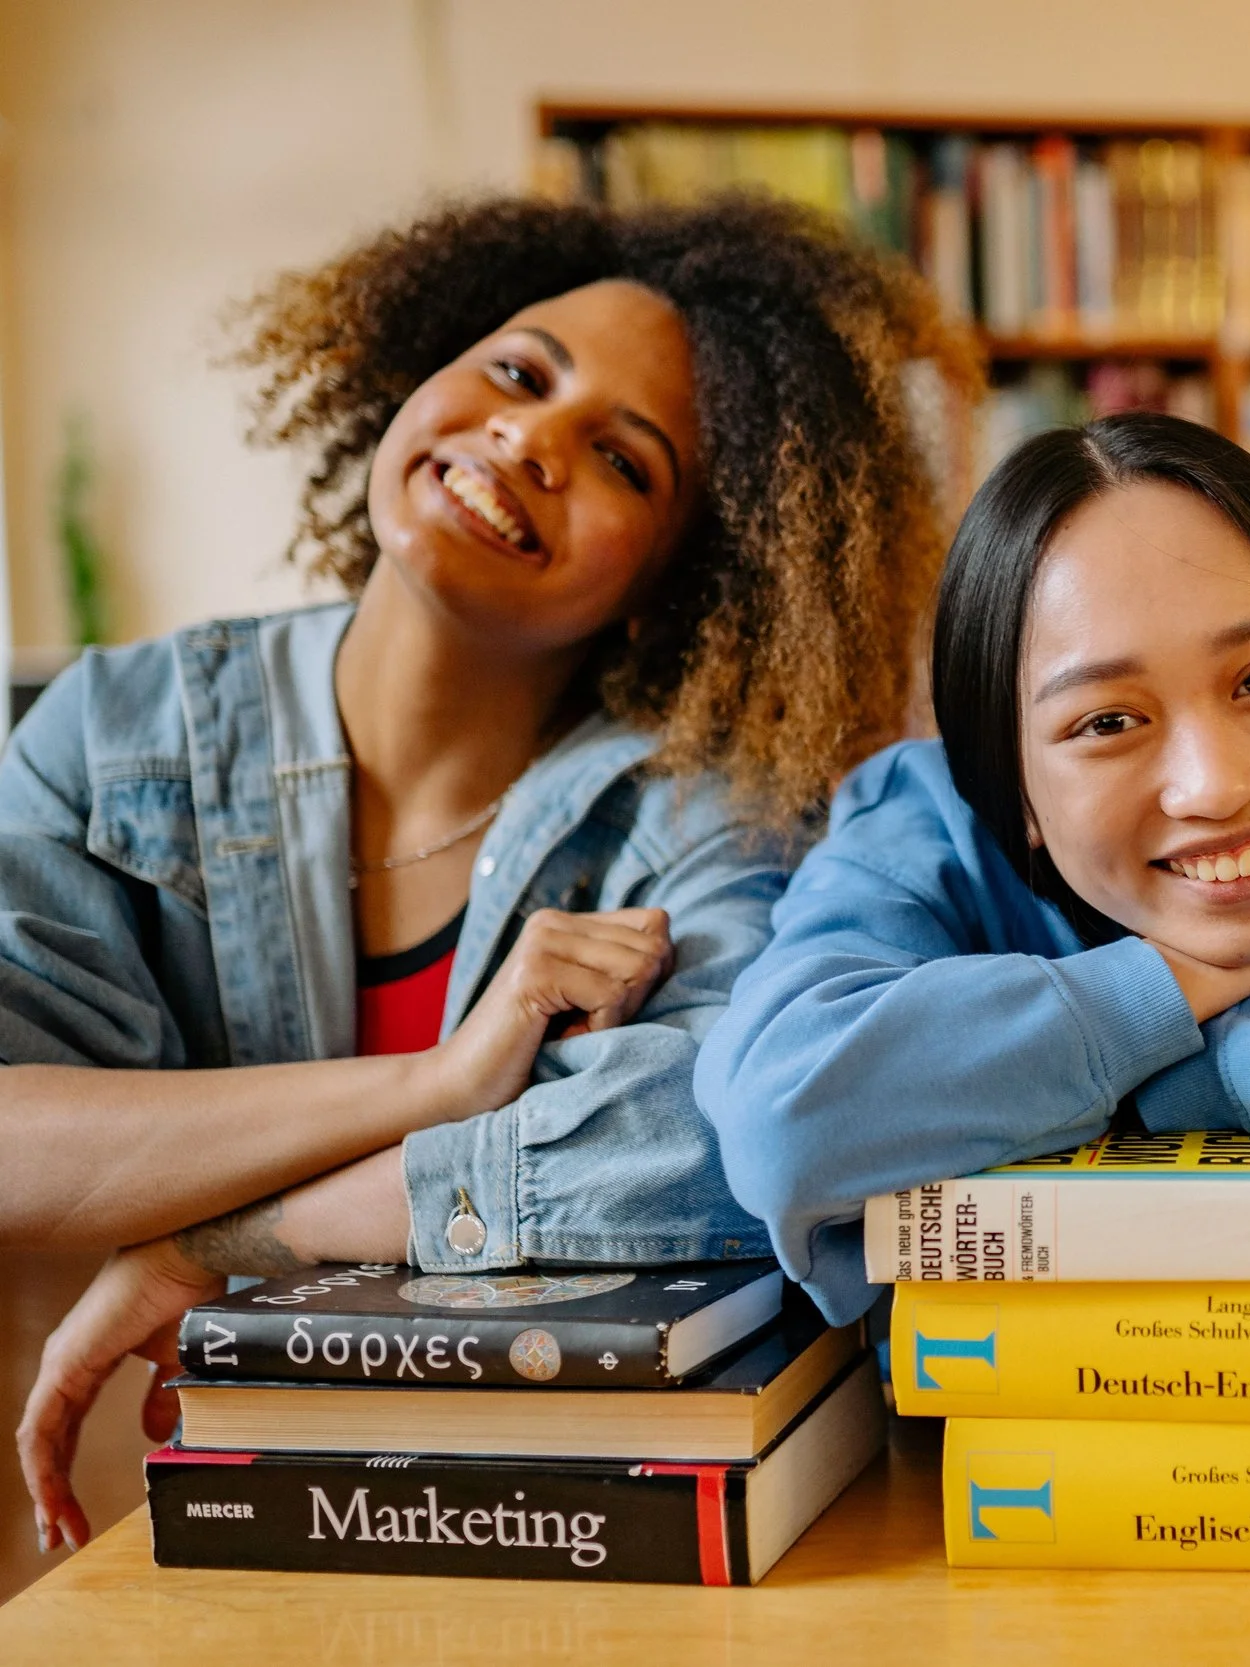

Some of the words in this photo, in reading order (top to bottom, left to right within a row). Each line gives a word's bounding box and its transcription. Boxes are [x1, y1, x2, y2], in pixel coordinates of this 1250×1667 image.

[896, 1187, 915, 1220] groß
[897, 1225, 911, 1256] neue
[920, 1183, 943, 1282] DEUTSCHE
[949, 1193, 978, 1282] WÖRTER-
[983, 1232, 1005, 1281] BUCH
[1037, 1246, 1049, 1272] BUCH
[1115, 1319, 1182, 1338] Großes
[1171, 1465, 1239, 1485] Großes
[187, 1502, 255, 1519] MERCER
[308, 1486, 607, 1567] Marketing
